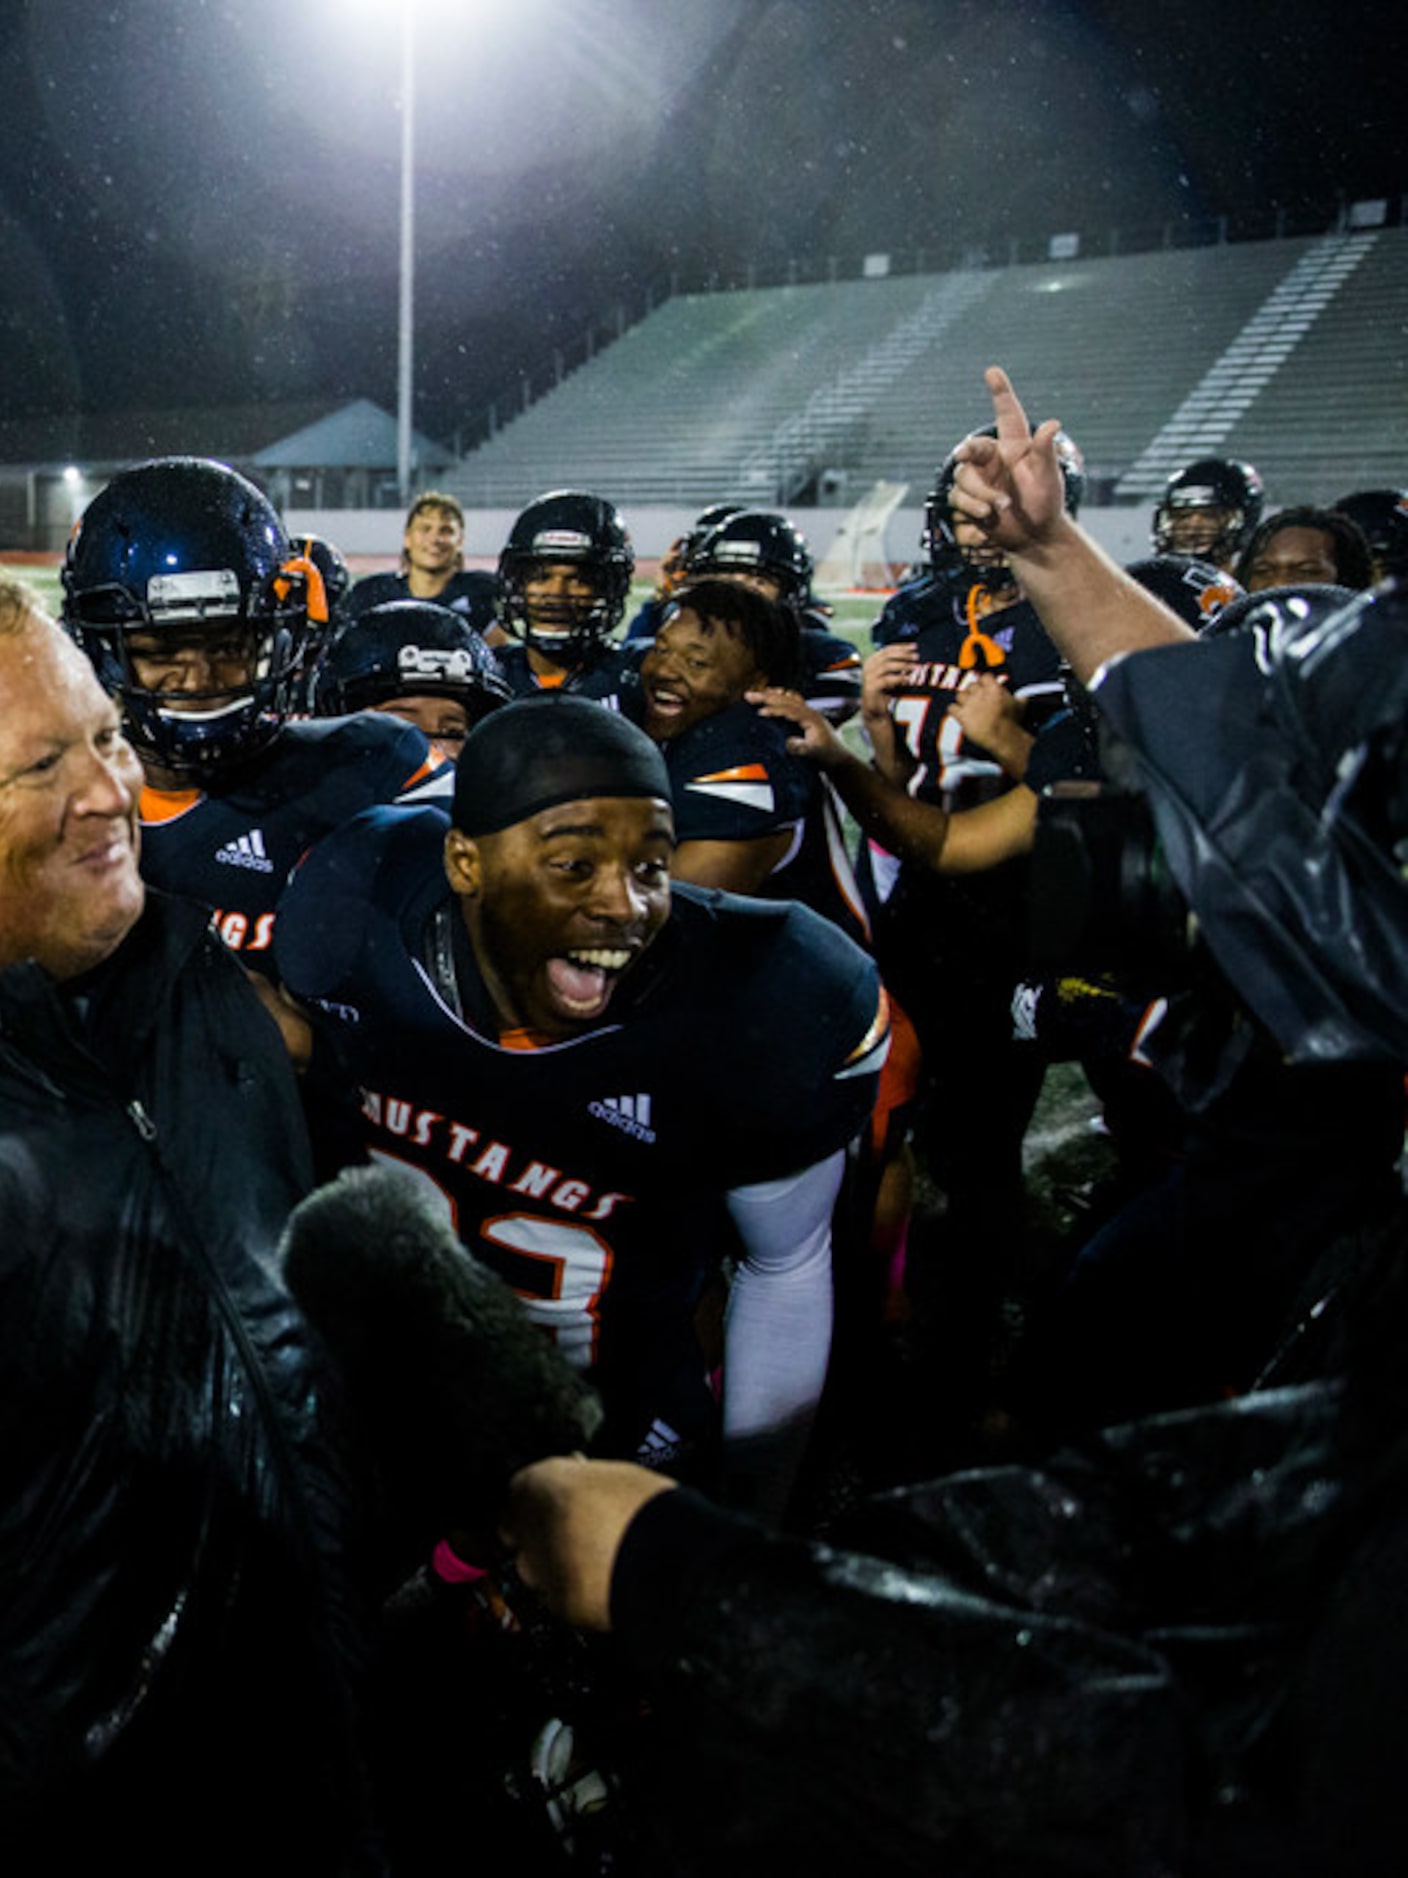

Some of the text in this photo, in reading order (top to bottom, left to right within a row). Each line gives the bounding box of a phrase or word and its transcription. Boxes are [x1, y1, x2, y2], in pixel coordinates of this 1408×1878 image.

[214, 847, 274, 873] adidas
[586, 1099, 657, 1145] adidas
[358, 1084, 636, 1220] MUSTANGS
